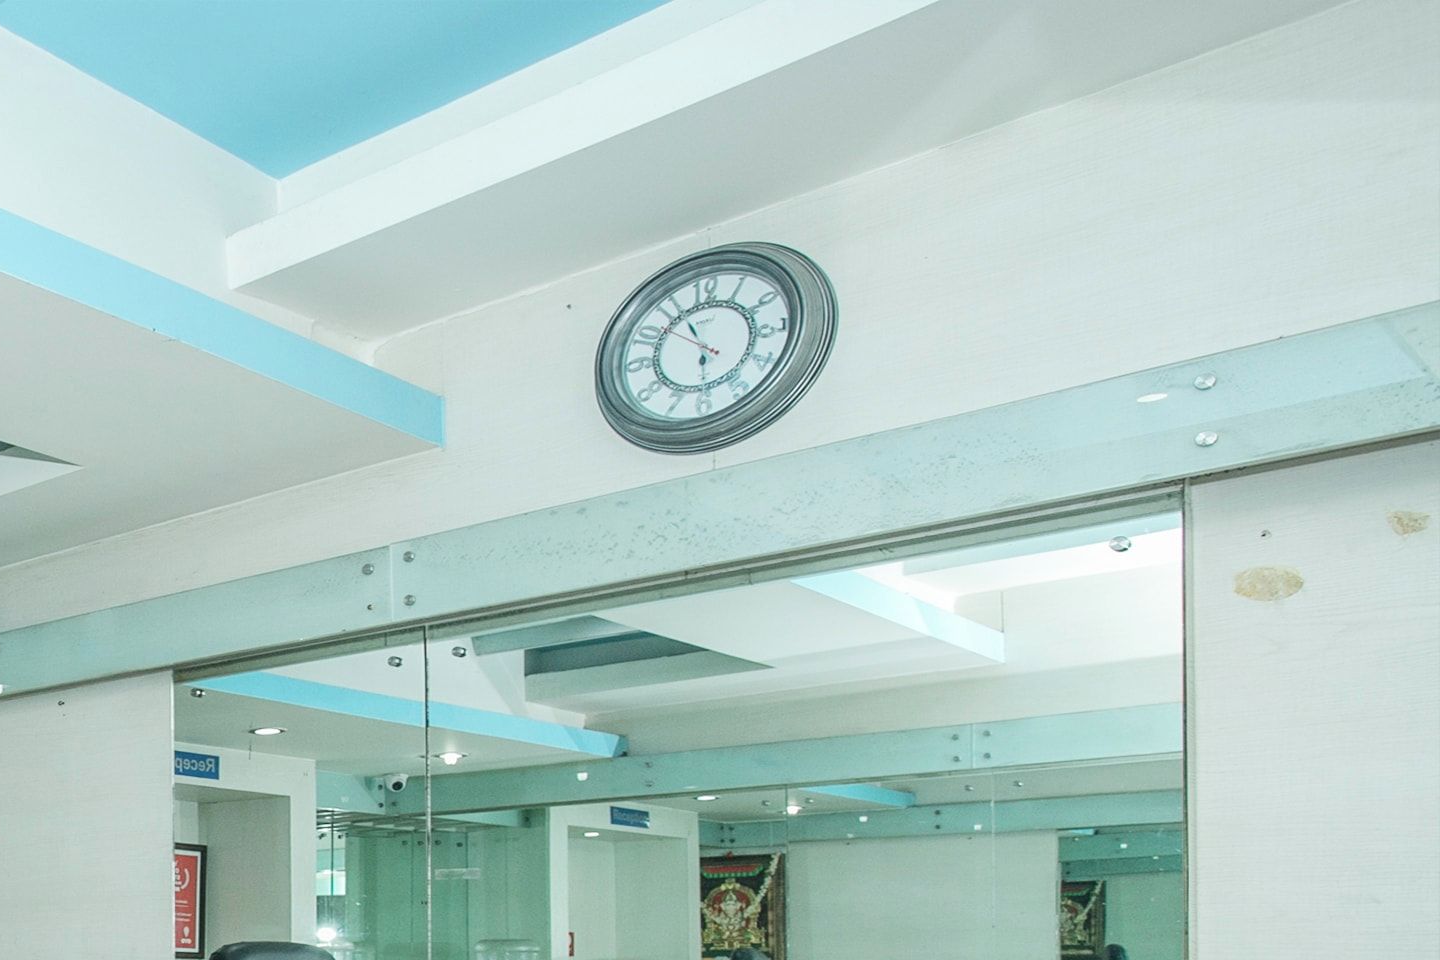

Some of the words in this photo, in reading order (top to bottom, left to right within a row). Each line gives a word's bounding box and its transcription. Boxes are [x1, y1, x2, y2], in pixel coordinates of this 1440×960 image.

[692, 275, 718, 304] 12
[730, 276, 747, 302] 1
[655, 295, 687, 320] 11
[749, 290, 780, 316] 2
[633, 325, 660, 348] 10
[758, 317, 787, 339] 3
[627, 357, 652, 373] 9
[751, 351, 775, 371] 4
[636, 381, 661, 402] 8
[728, 374, 750, 400] 5
[665, 393, 684, 416] 7
[695, 391, 712, 415] 6
